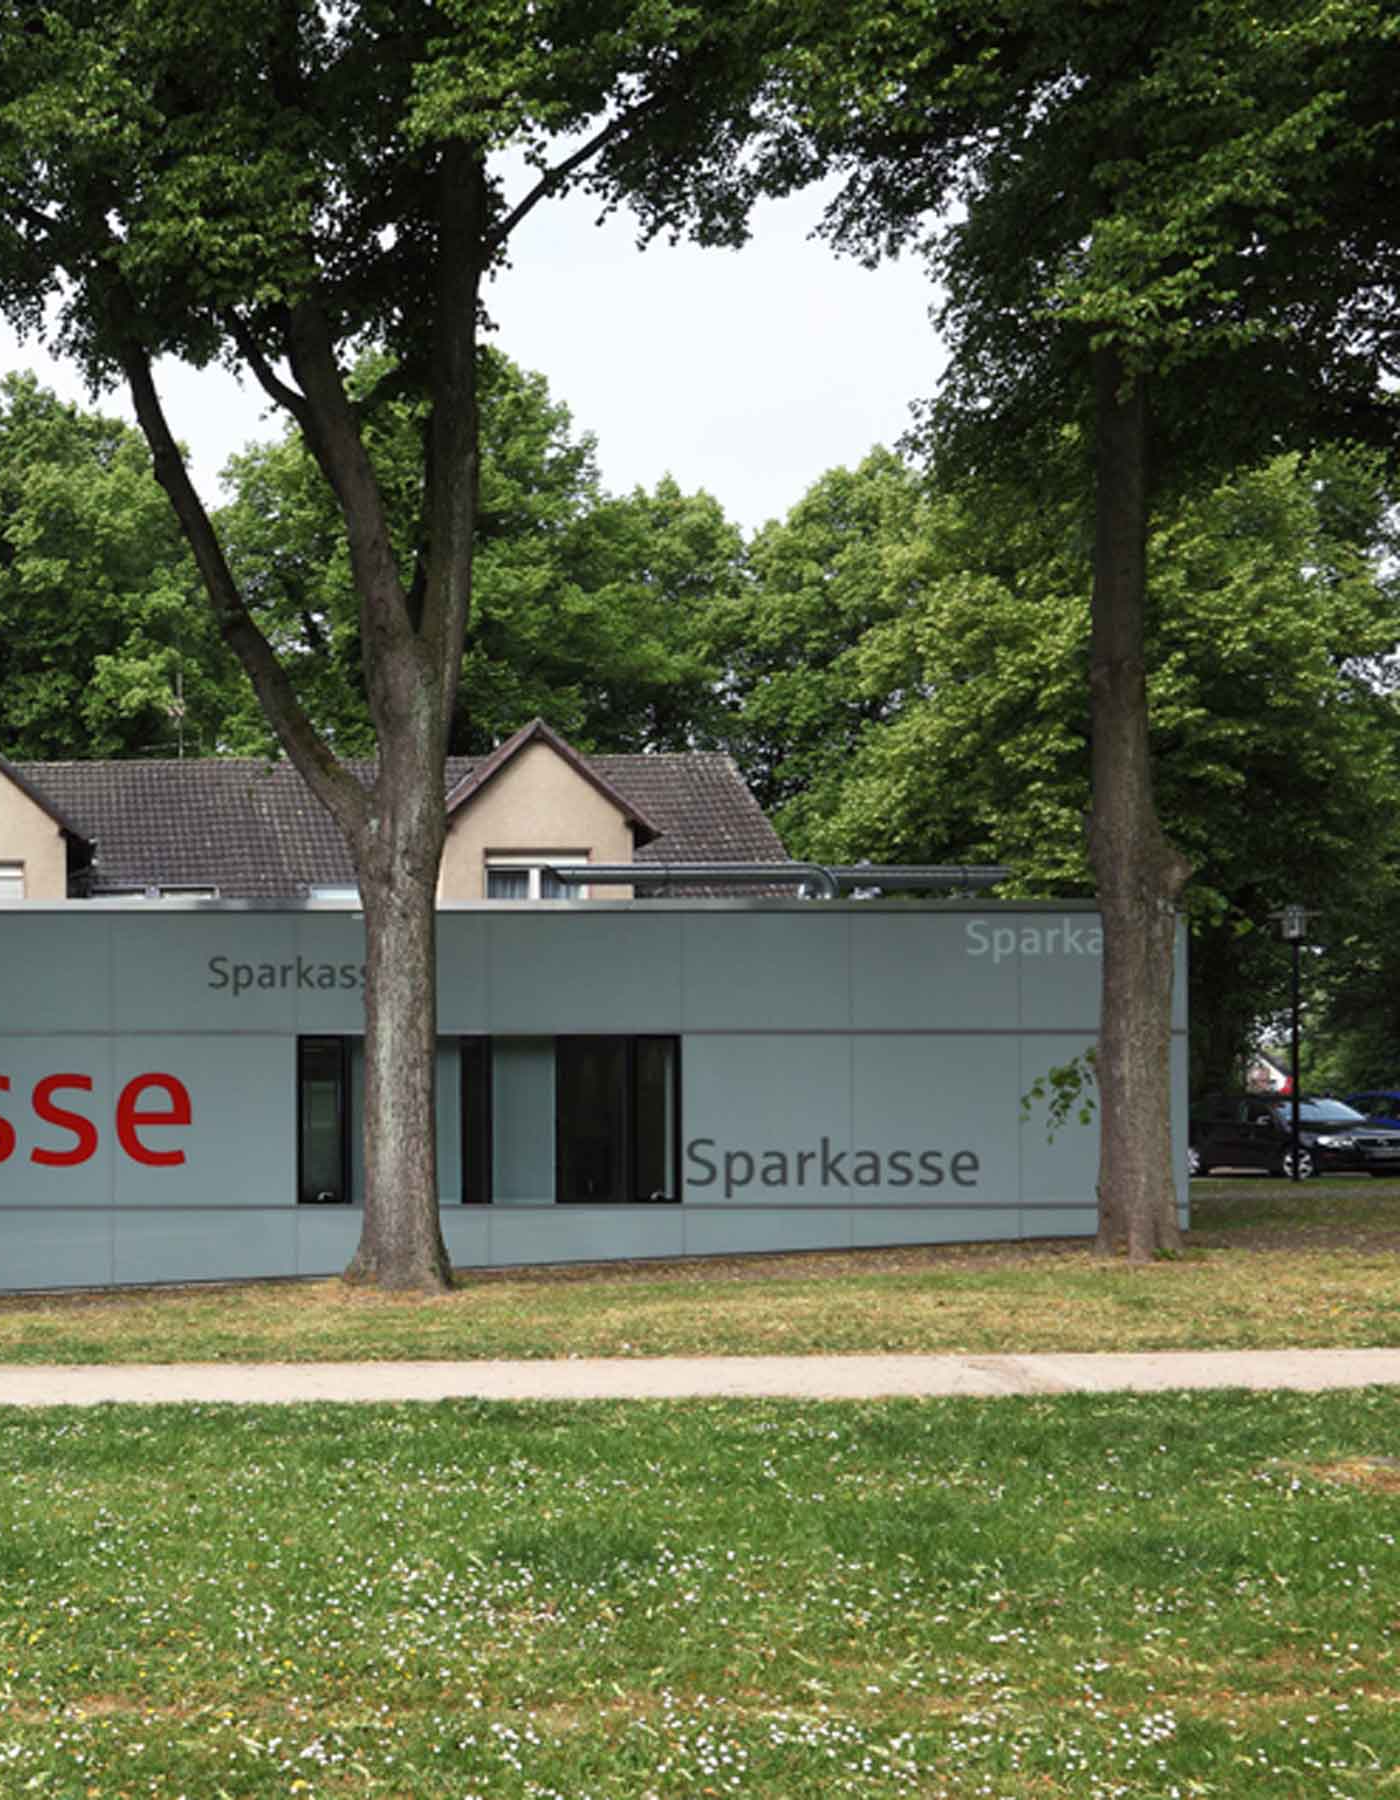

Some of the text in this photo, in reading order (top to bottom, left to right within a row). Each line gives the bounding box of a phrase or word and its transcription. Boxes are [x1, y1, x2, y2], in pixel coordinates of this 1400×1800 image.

[965, 917, 1104, 964] Sparka
[207, 955, 369, 997] Sparkas
[685, 1137, 980, 1199] Sparkasse
